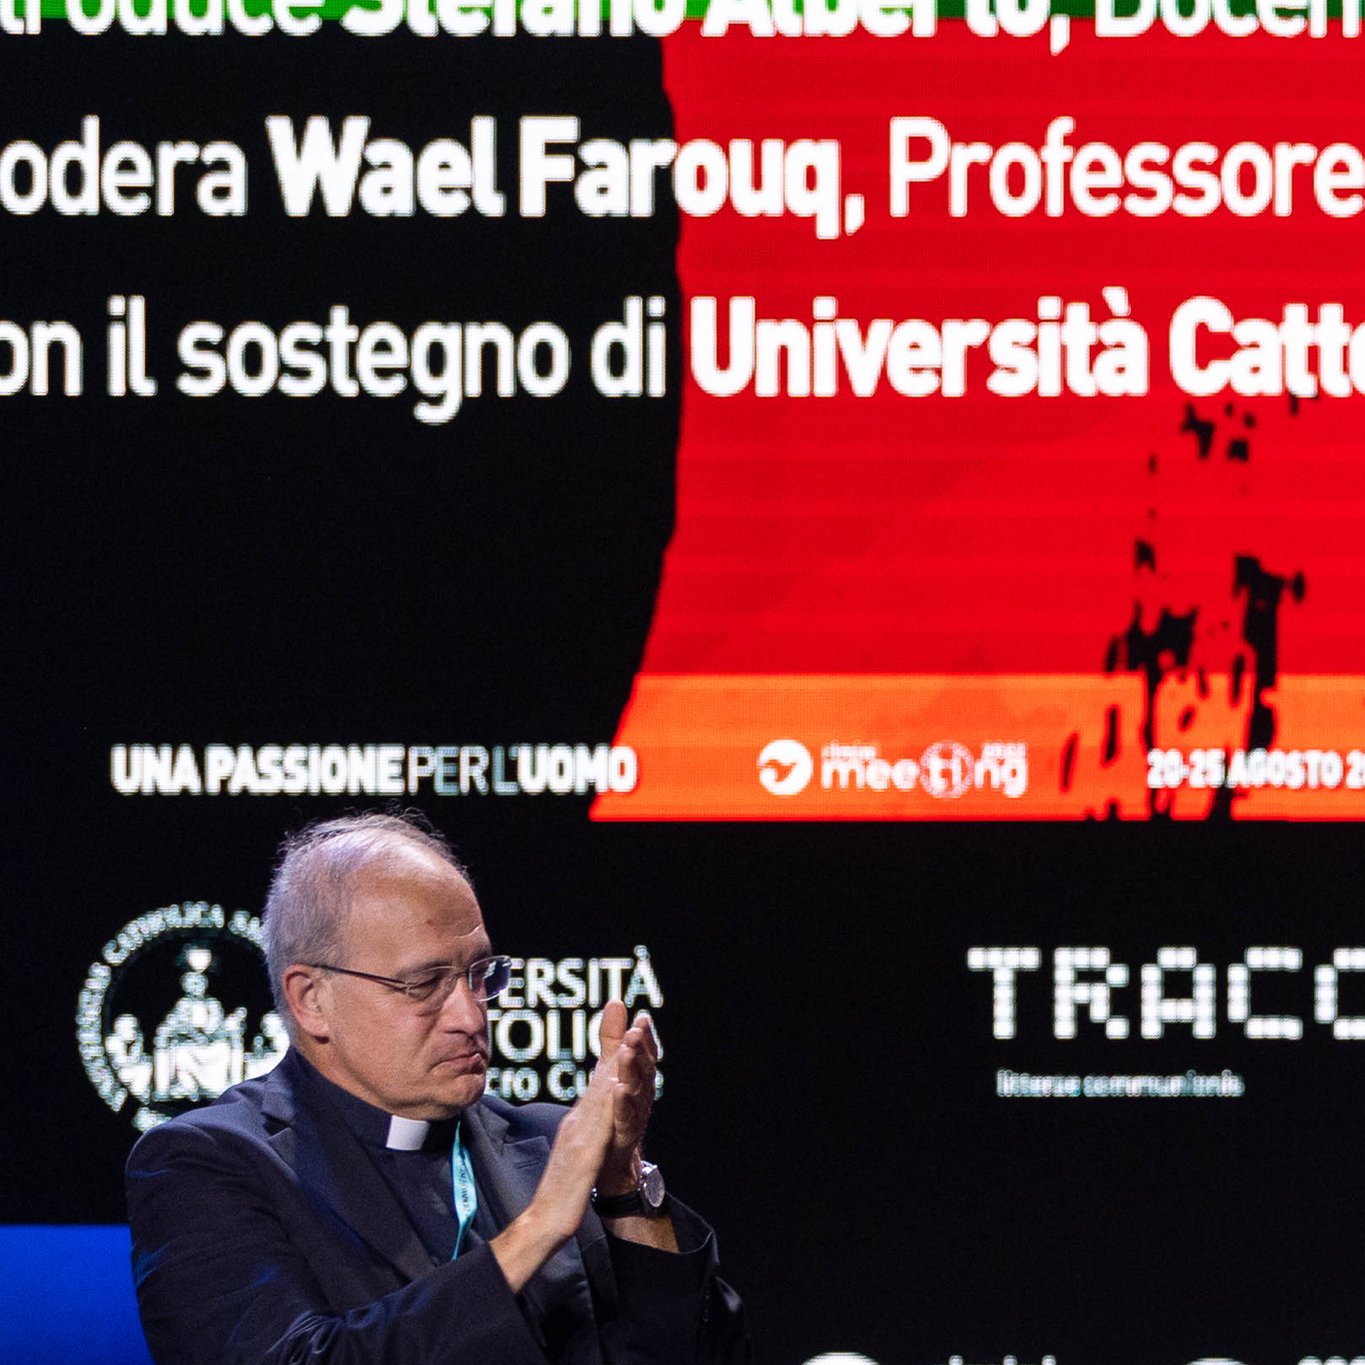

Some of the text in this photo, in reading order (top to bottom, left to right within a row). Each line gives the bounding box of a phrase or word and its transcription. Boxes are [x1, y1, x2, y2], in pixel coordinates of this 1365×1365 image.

[265, 115, 504, 217] Wael
[520, 116, 864, 239] Farouq,
[108, 295, 155, 397] il
[177, 306, 569, 424] sostegno
[592, 295, 665, 397] di
[690, 287, 1148, 397] Università
[111, 744, 202, 795] UNA
[821, 744, 1028, 798] meeting
[1227, 748, 1344, 789] AGOSTO
[497, 944, 664, 1008] ERSITÀ
